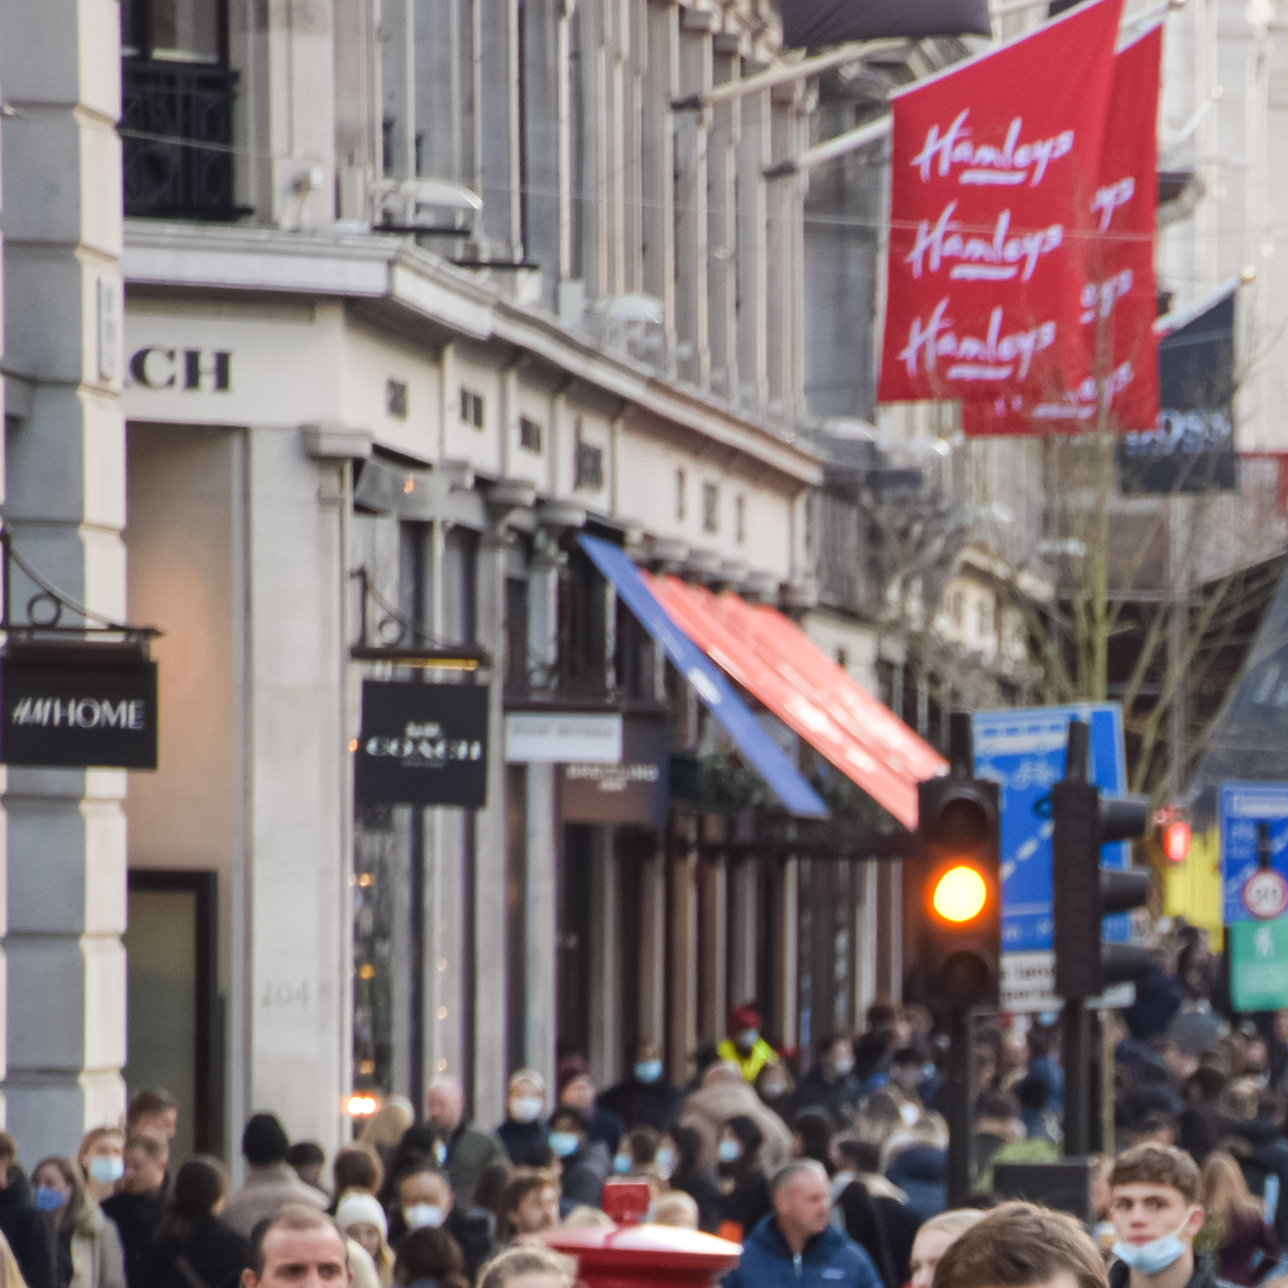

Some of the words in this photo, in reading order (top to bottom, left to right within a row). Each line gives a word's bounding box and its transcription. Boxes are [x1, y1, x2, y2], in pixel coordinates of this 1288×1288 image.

[910, 107, 1074, 187] Hamleys
[903, 200, 1064, 282] Hamleys
[897, 297, 1056, 381] Hamleys
[53, 697, 145, 729] HOME
[366, 737, 481, 760] COACH
